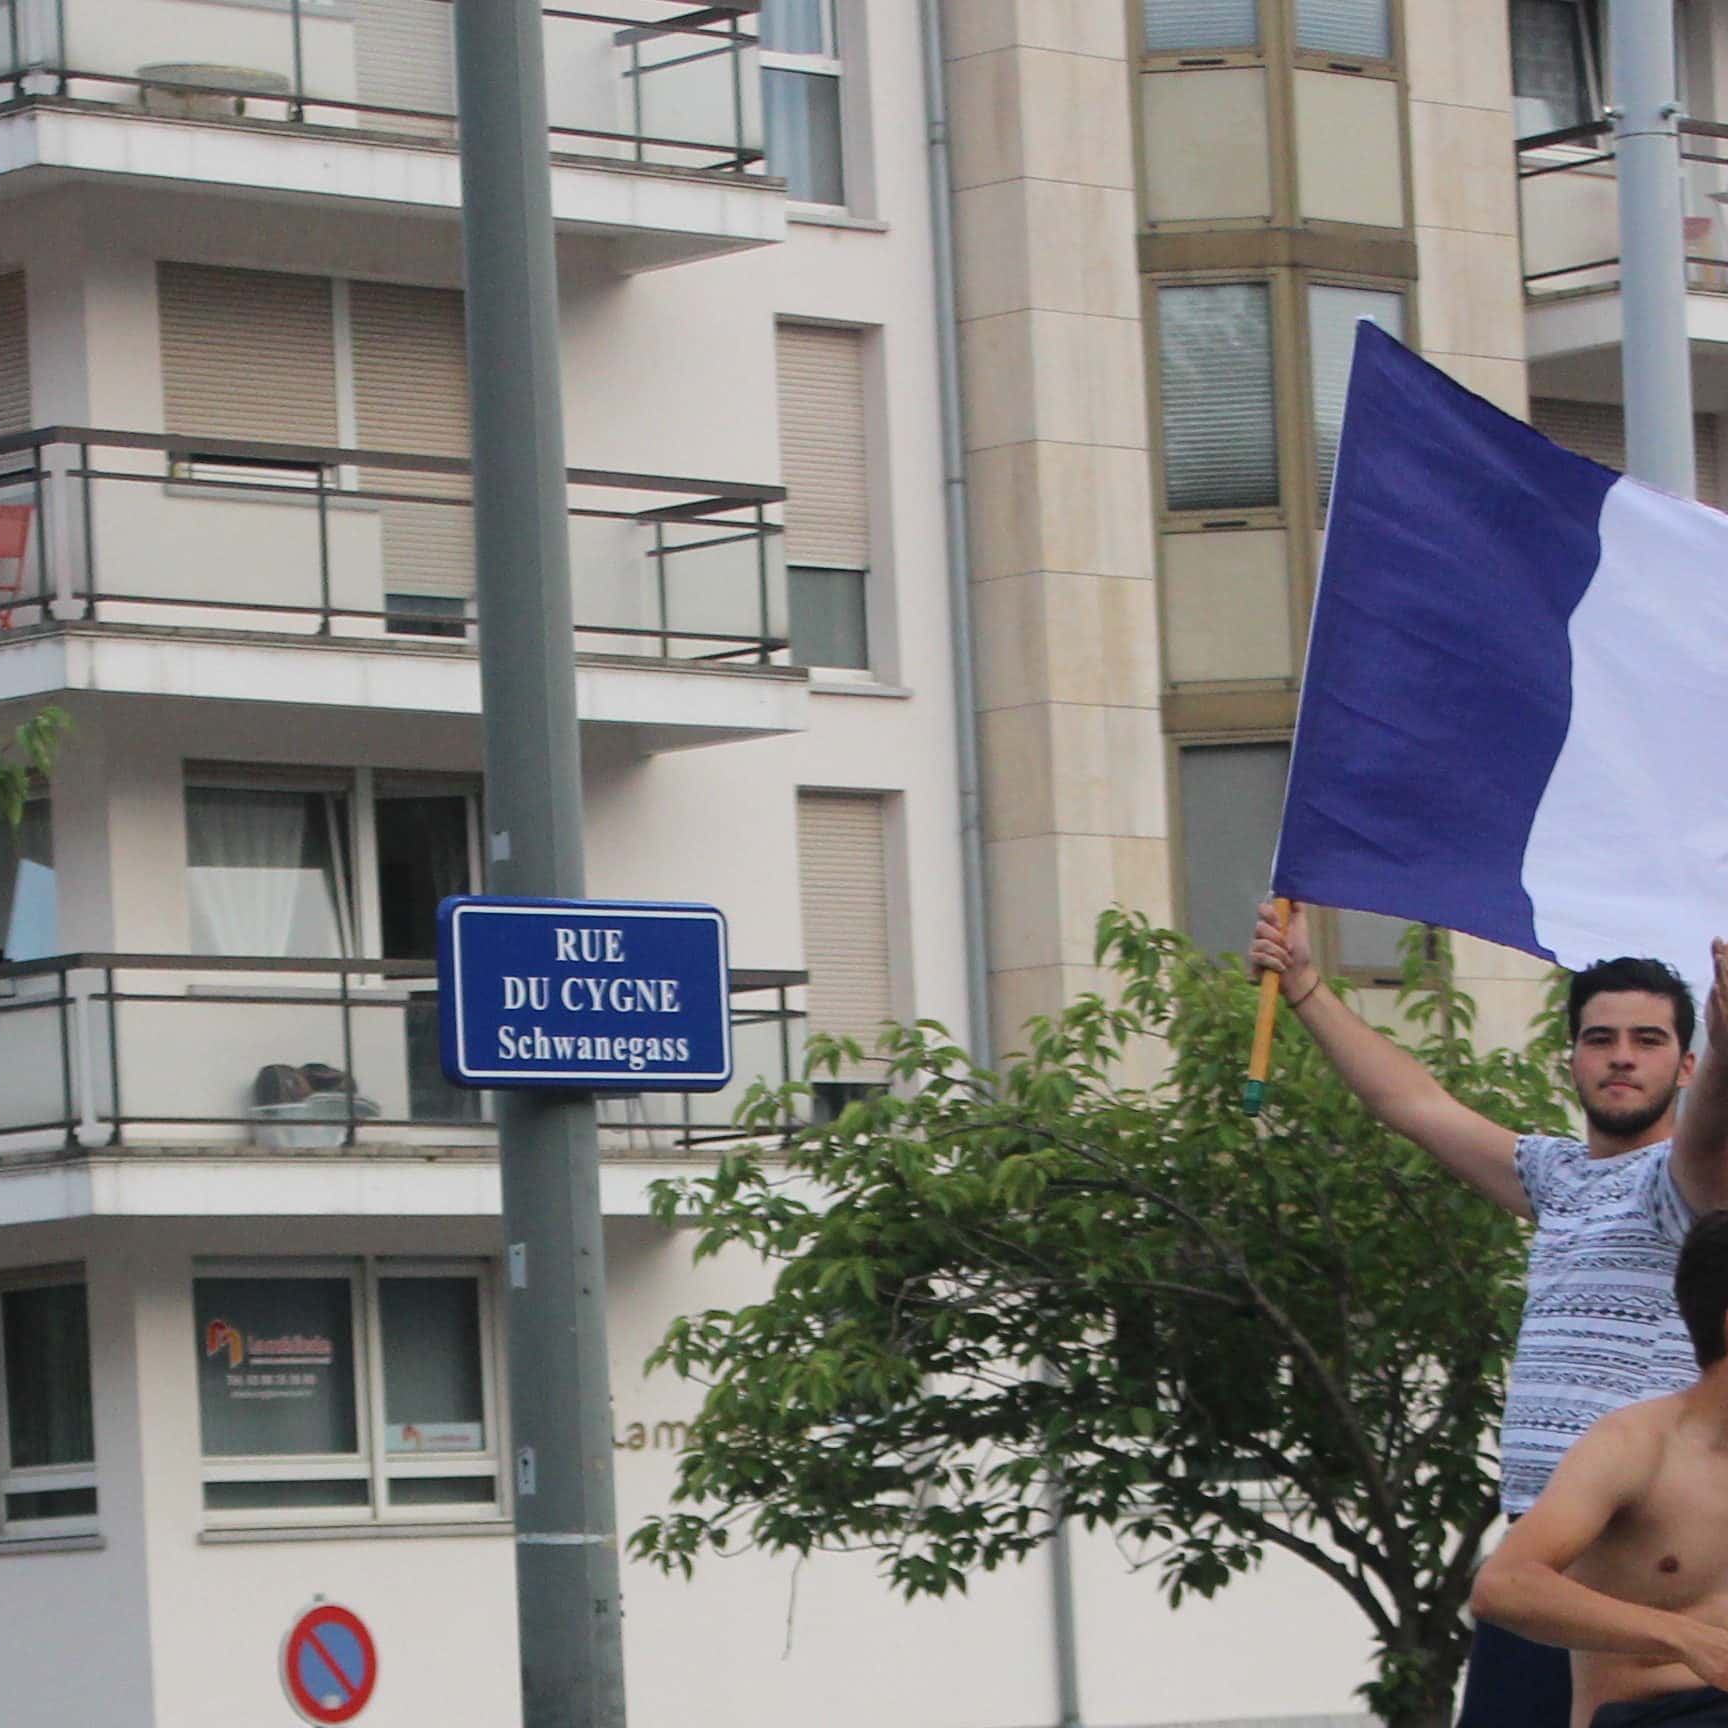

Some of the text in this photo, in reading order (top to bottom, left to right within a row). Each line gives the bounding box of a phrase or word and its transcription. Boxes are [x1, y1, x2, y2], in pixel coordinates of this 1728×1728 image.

[555, 927, 626, 962] RUE
[503, 976, 681, 1013] DU CYGNE
[498, 1025, 690, 1071] Schwanegass
